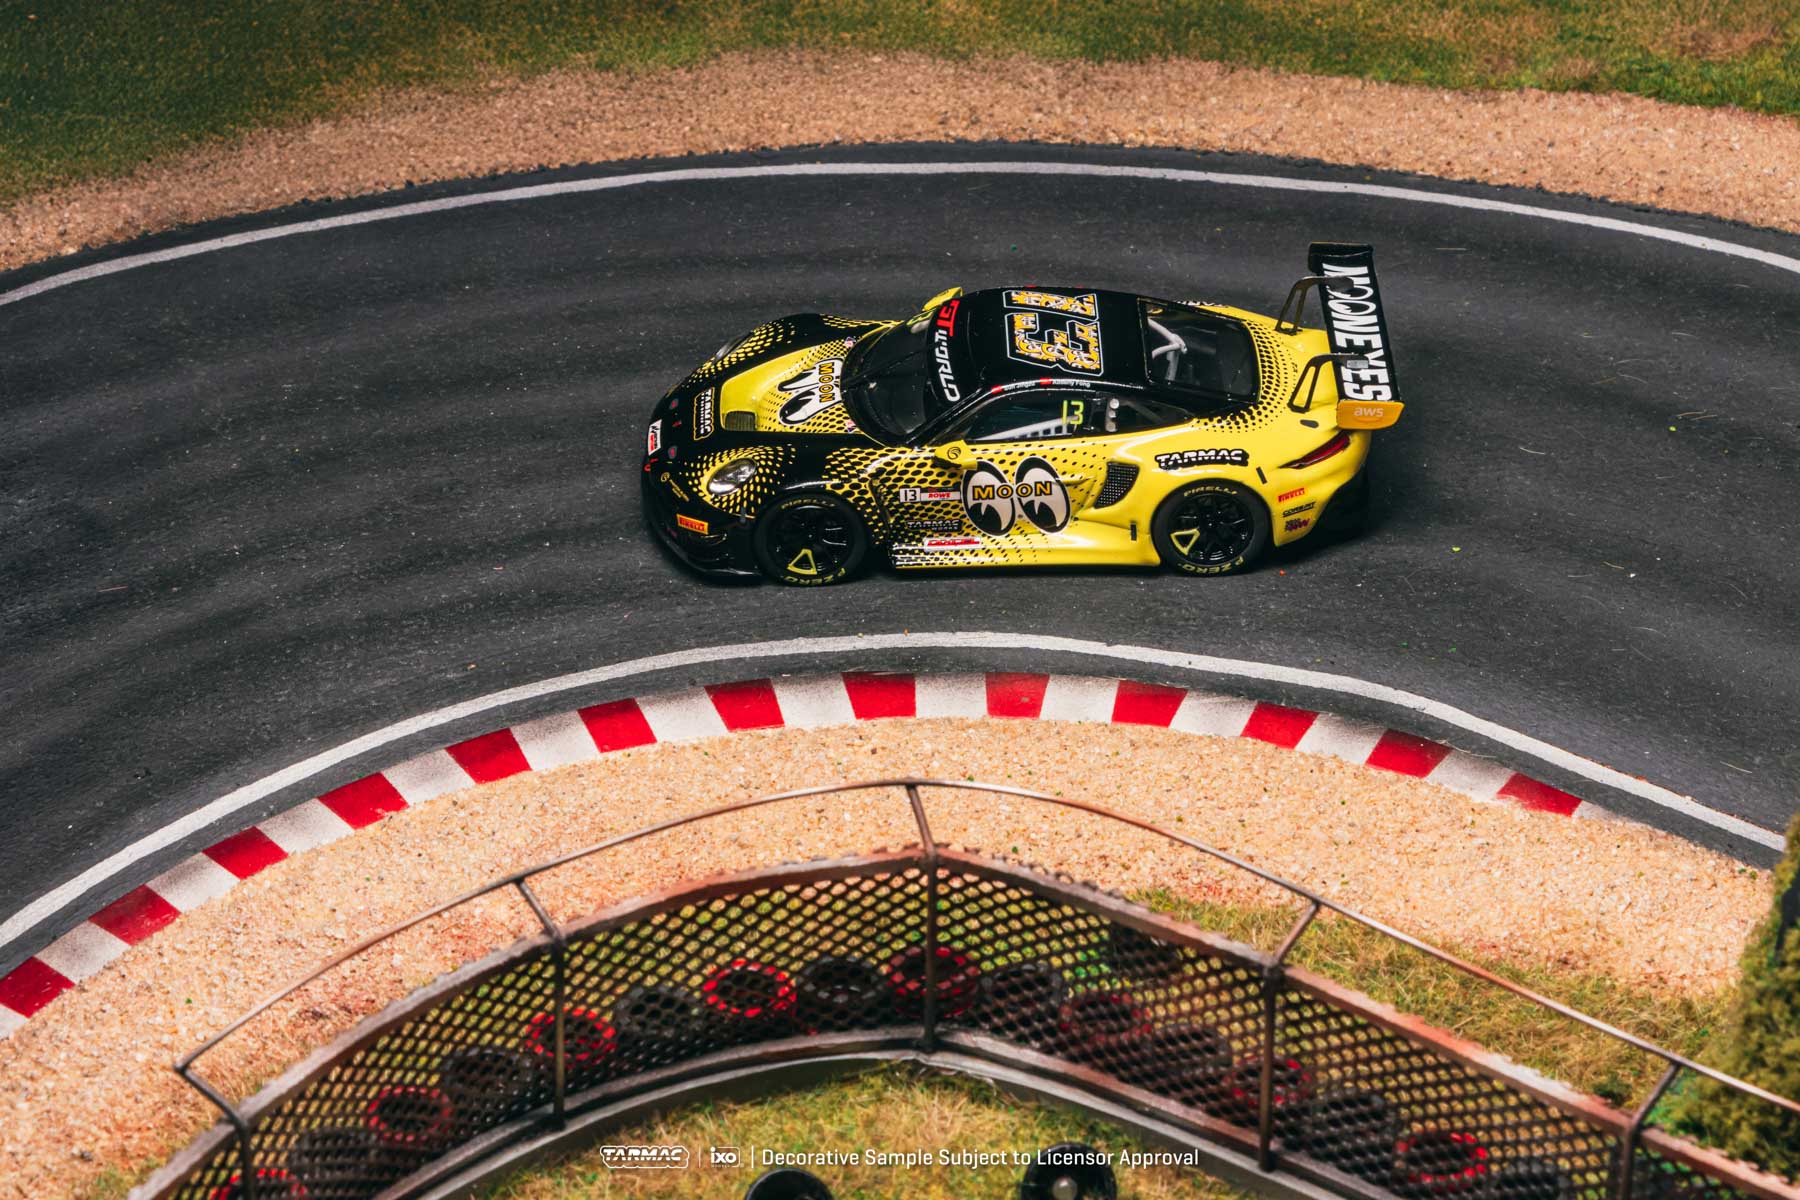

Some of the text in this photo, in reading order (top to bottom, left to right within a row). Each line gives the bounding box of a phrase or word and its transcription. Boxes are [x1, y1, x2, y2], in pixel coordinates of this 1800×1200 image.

[1006, 290, 1102, 373] 13
[818, 362, 836, 403] MOON
[1062, 400, 1084, 425] 13
[1354, 406, 1384, 417] aws
[1156, 449, 1244, 467] TARMAC
[903, 489, 917, 501] 13
[972, 481, 1052, 501] MOON
